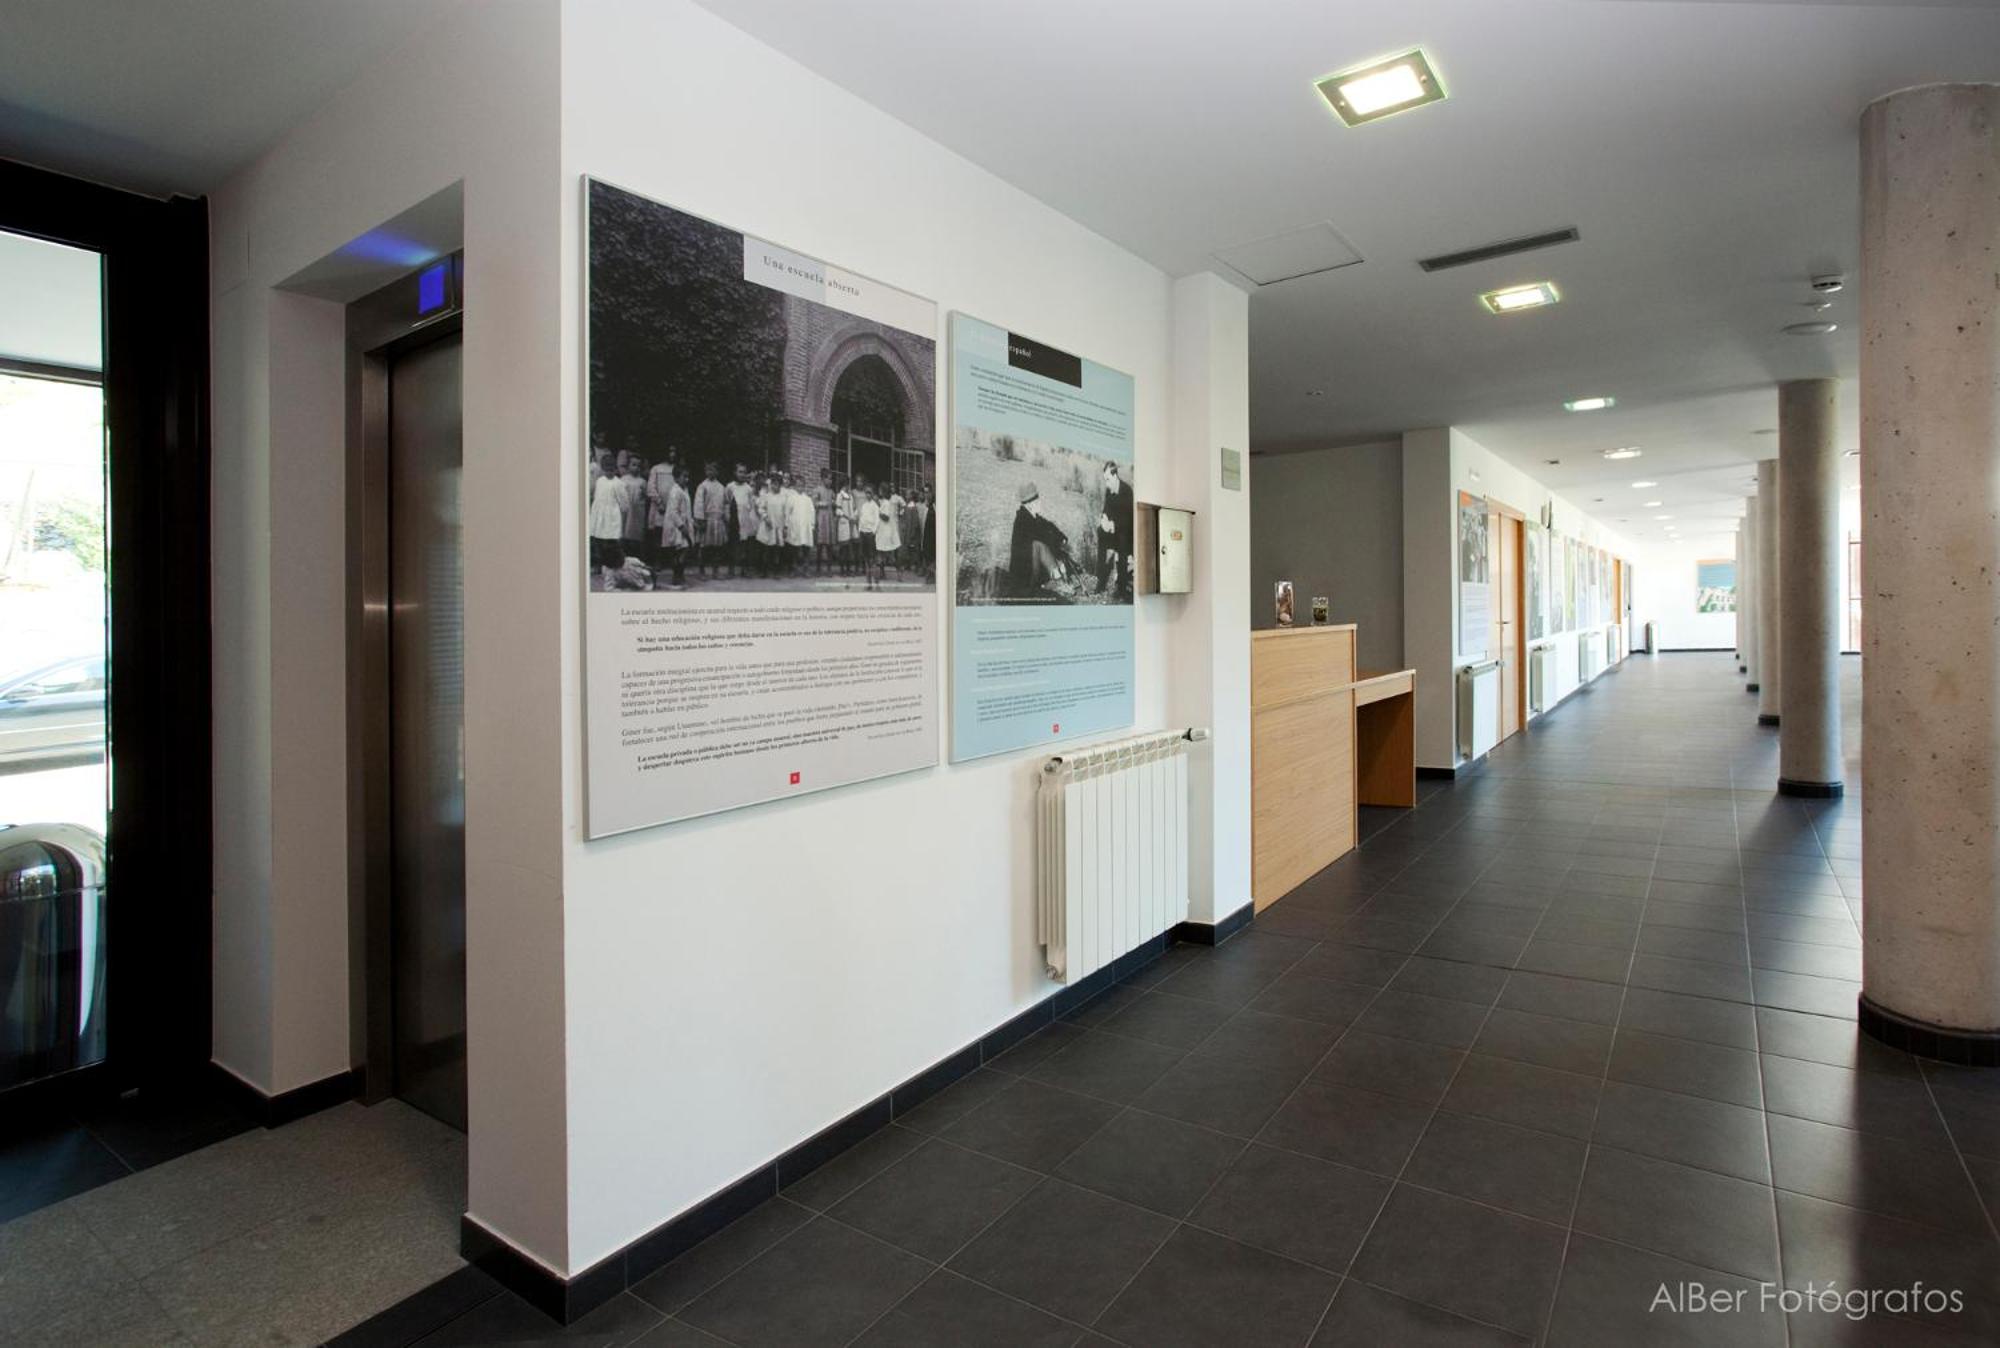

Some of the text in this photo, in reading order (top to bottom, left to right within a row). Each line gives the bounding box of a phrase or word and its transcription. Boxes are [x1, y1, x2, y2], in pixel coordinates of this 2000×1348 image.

[763, 255, 860, 296] Una escuela abierta
